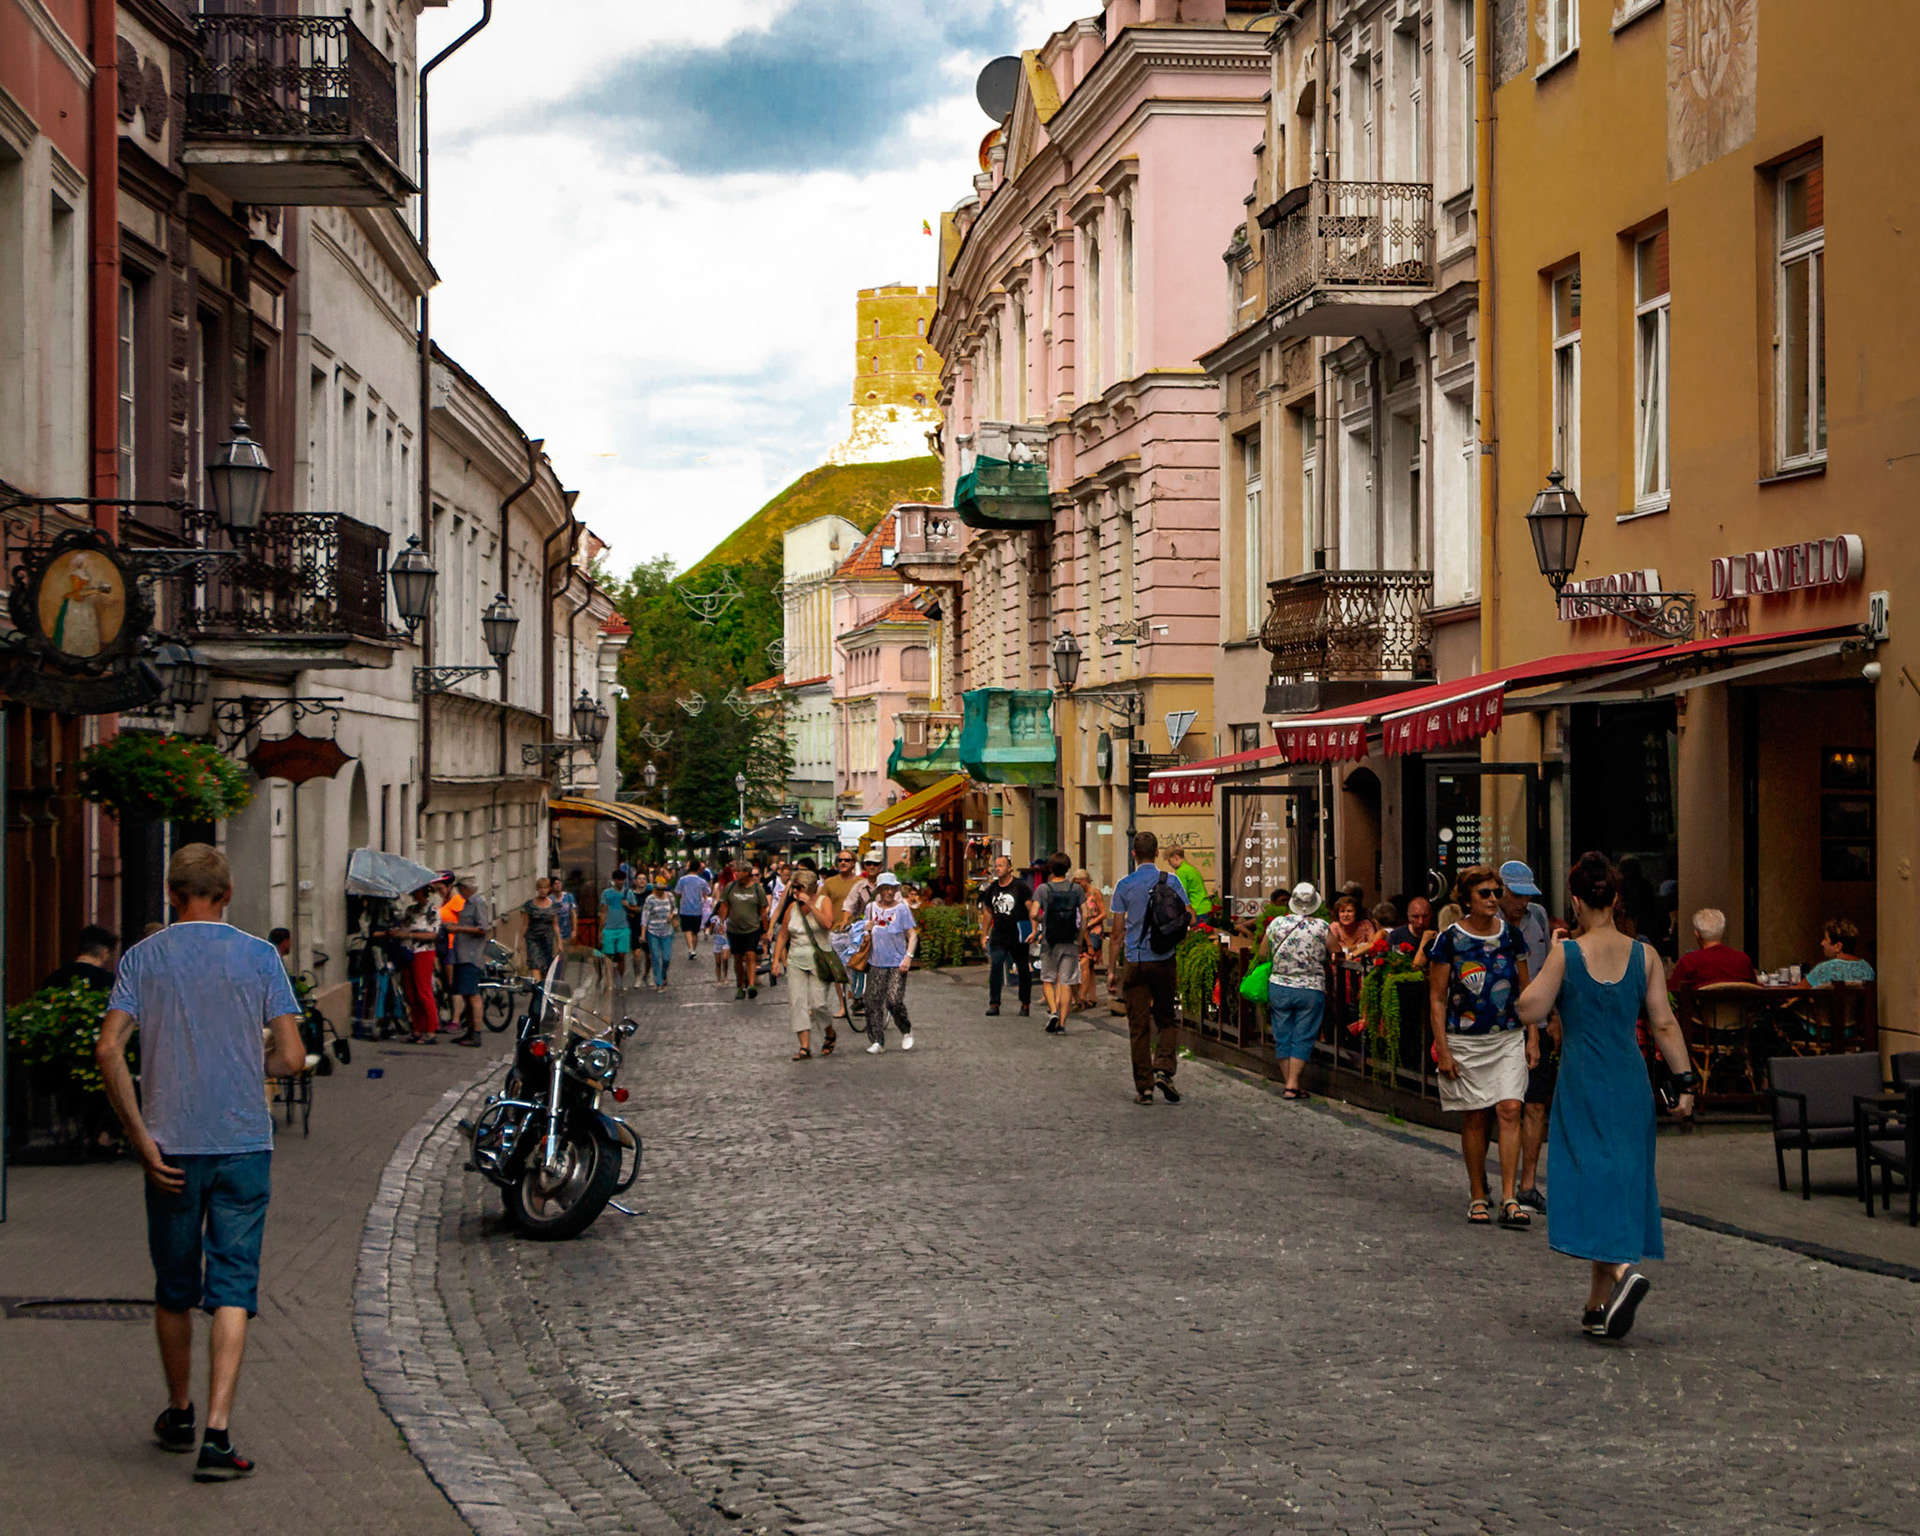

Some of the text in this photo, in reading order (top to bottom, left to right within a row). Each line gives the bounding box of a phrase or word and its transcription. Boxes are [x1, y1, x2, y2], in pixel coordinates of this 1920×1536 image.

[1711, 555, 1738, 600] DI
[1746, 534, 1854, 594] RAVELLO
[1871, 597, 1883, 634] 20
